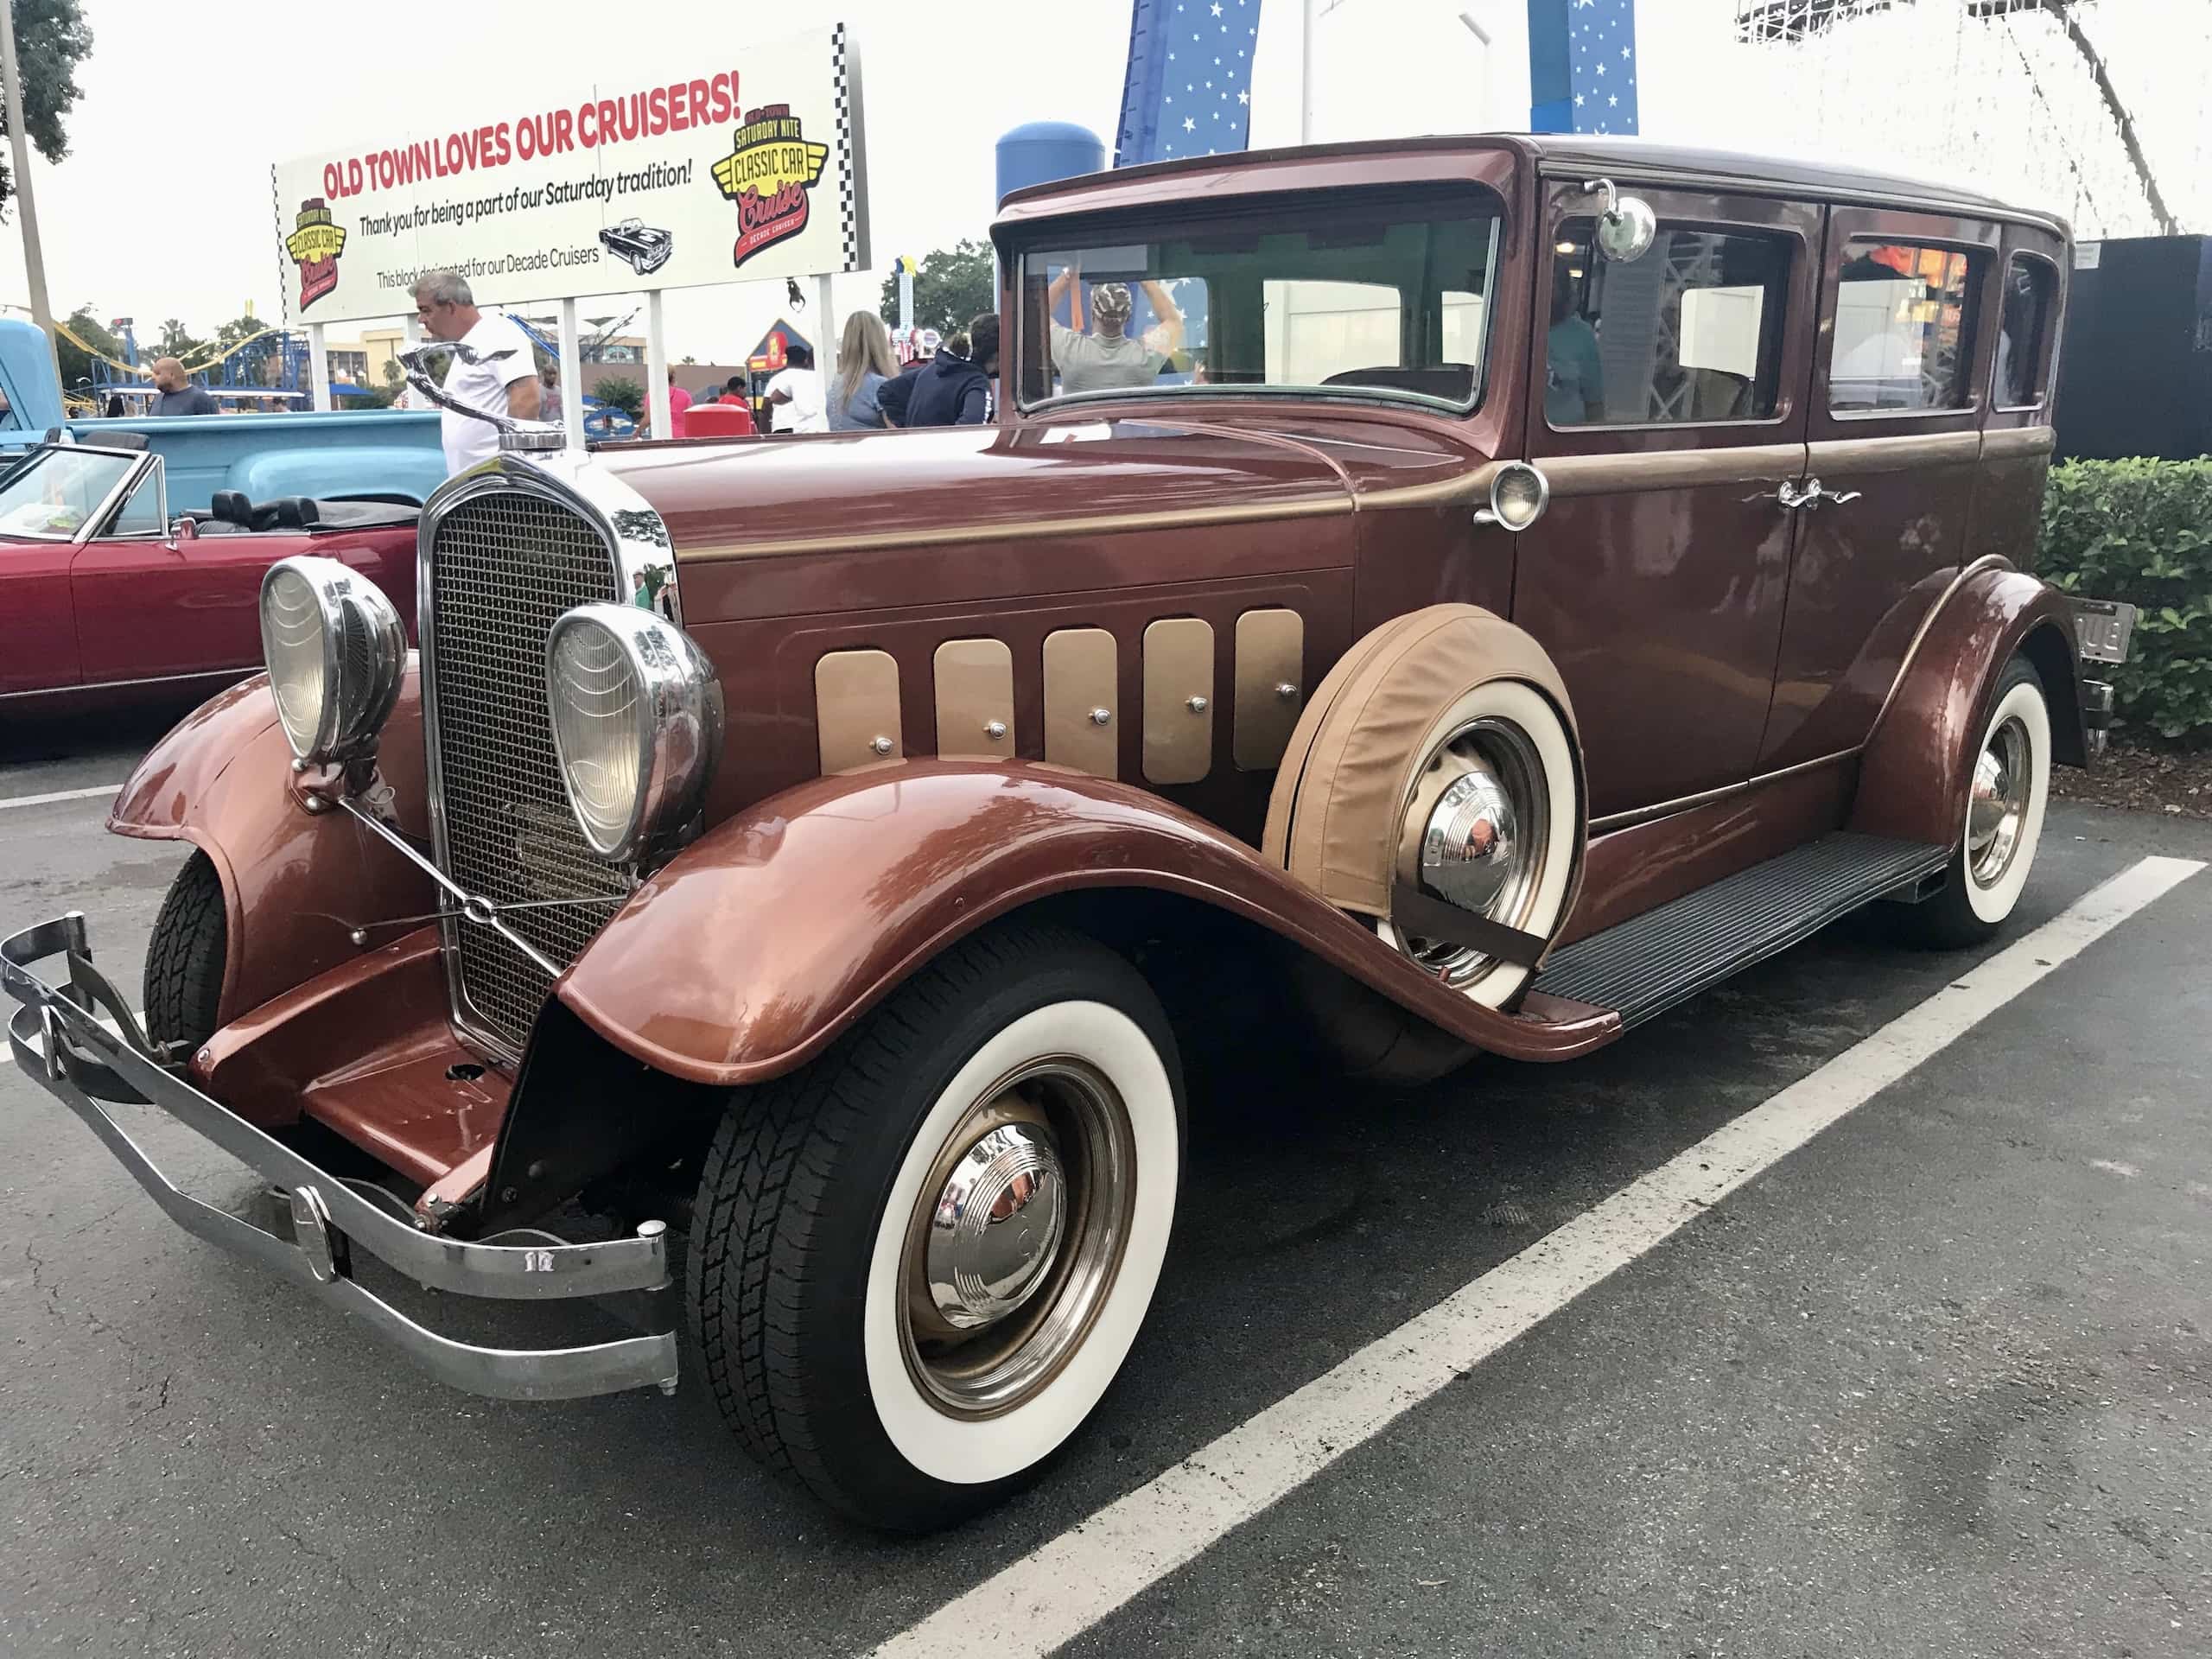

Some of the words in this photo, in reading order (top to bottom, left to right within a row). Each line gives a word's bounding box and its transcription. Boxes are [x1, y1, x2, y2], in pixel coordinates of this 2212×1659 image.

[324, 158, 363, 200] OLD
[365, 141, 432, 191] TOWN
[434, 123, 511, 177] LOVES
[516, 109, 574, 161] OUR
[578, 70, 741, 149] CRUISERS!
[736, 119, 778, 149] SATURDAY
[780, 118, 800, 138] NITE
[734, 149, 779, 185] CLASSIC
[781, 148, 805, 175] CAR
[359, 212, 392, 237] Thank
[393, 213, 412, 237] you
[413, 206, 430, 227] for
[432, 199, 464, 226] being
[466, 201, 474, 218] a
[475, 192, 504, 222] part
[505, 187, 519, 210] of
[520, 188, 543, 209] our
[545, 173, 615, 205] Saturday
[617, 158, 692, 194] tradition!
[737, 180, 804, 233] Cruise
[377, 270, 396, 289] This
[472, 257, 486, 276] for
[487, 259, 505, 276] our
[506, 249, 549, 272] Decade
[550, 245, 600, 268] Cruisers
